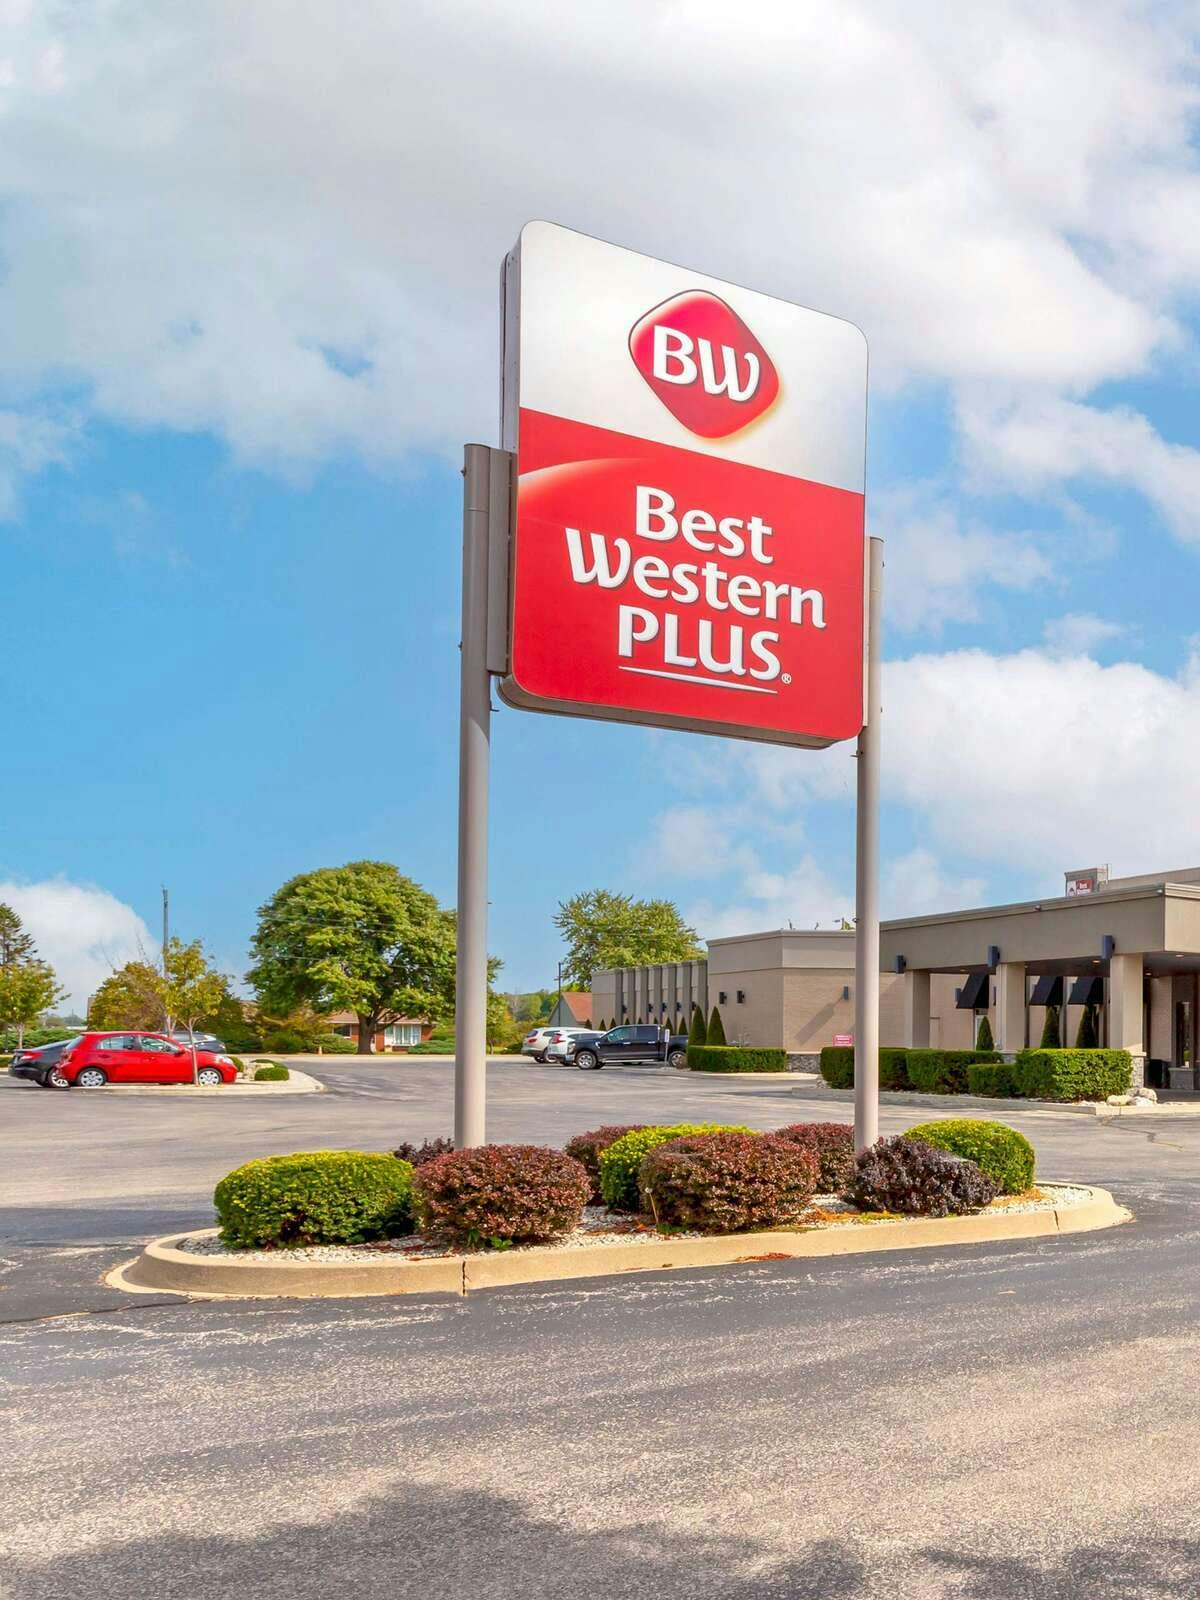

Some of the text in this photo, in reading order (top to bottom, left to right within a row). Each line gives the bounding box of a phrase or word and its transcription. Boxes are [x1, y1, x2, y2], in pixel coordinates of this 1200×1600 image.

[652, 325, 760, 402] BW
[635, 485, 774, 564] Best
[565, 527, 827, 628] Western
[618, 604, 781, 680] PLUS
